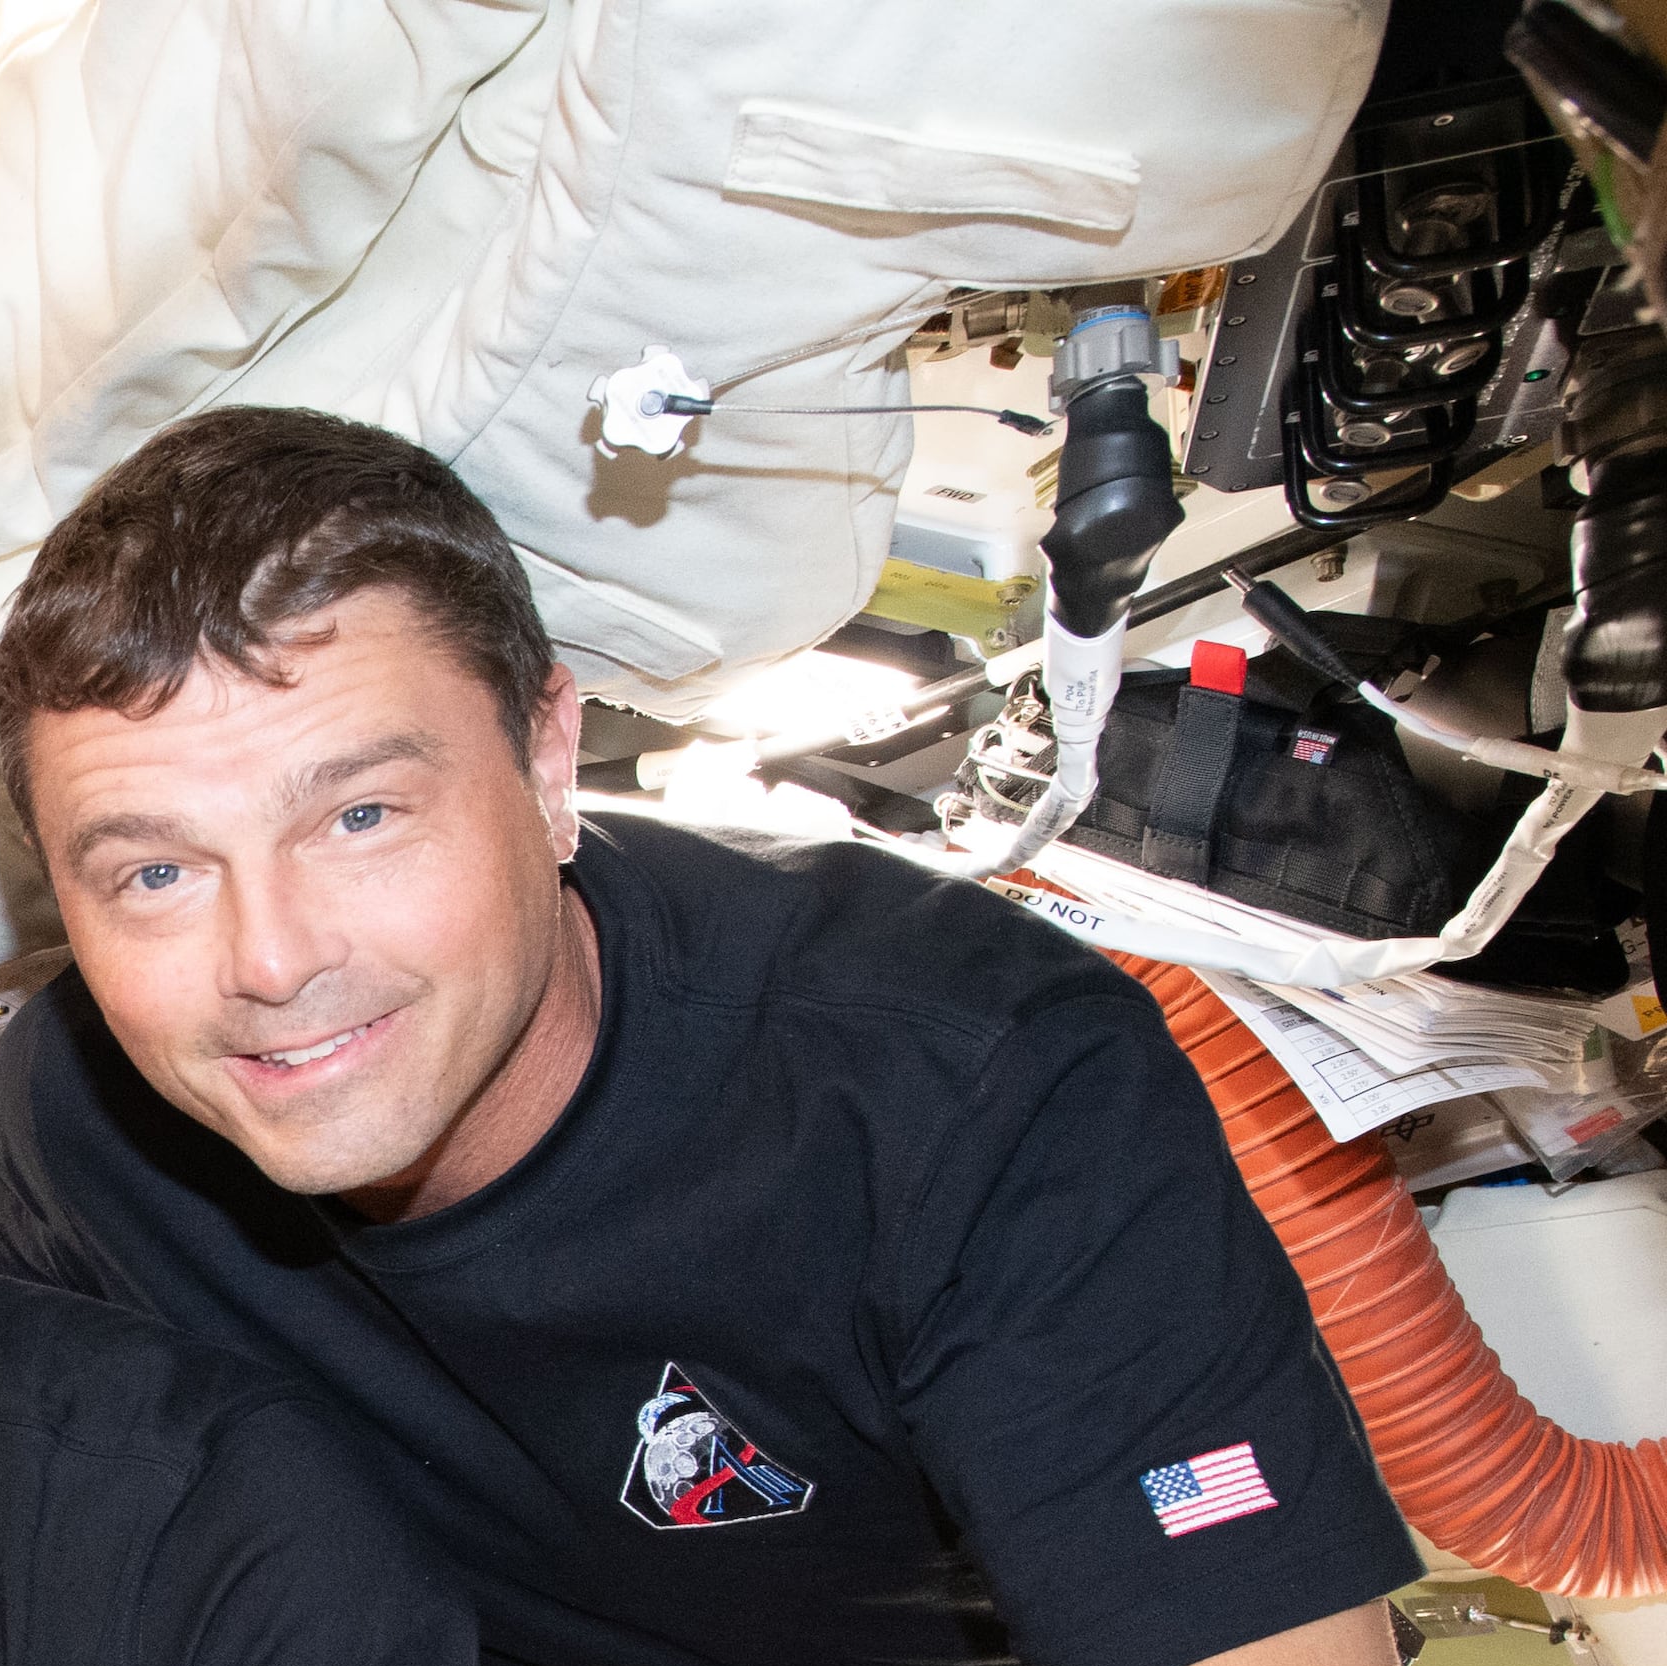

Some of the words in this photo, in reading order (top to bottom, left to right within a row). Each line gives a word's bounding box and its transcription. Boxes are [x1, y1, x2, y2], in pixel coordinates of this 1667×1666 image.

[935, 486, 975, 502] FWD
[1004, 886, 1043, 907] DO
[1049, 901, 1105, 931] NOT
[1362, 981, 1388, 998] Note
